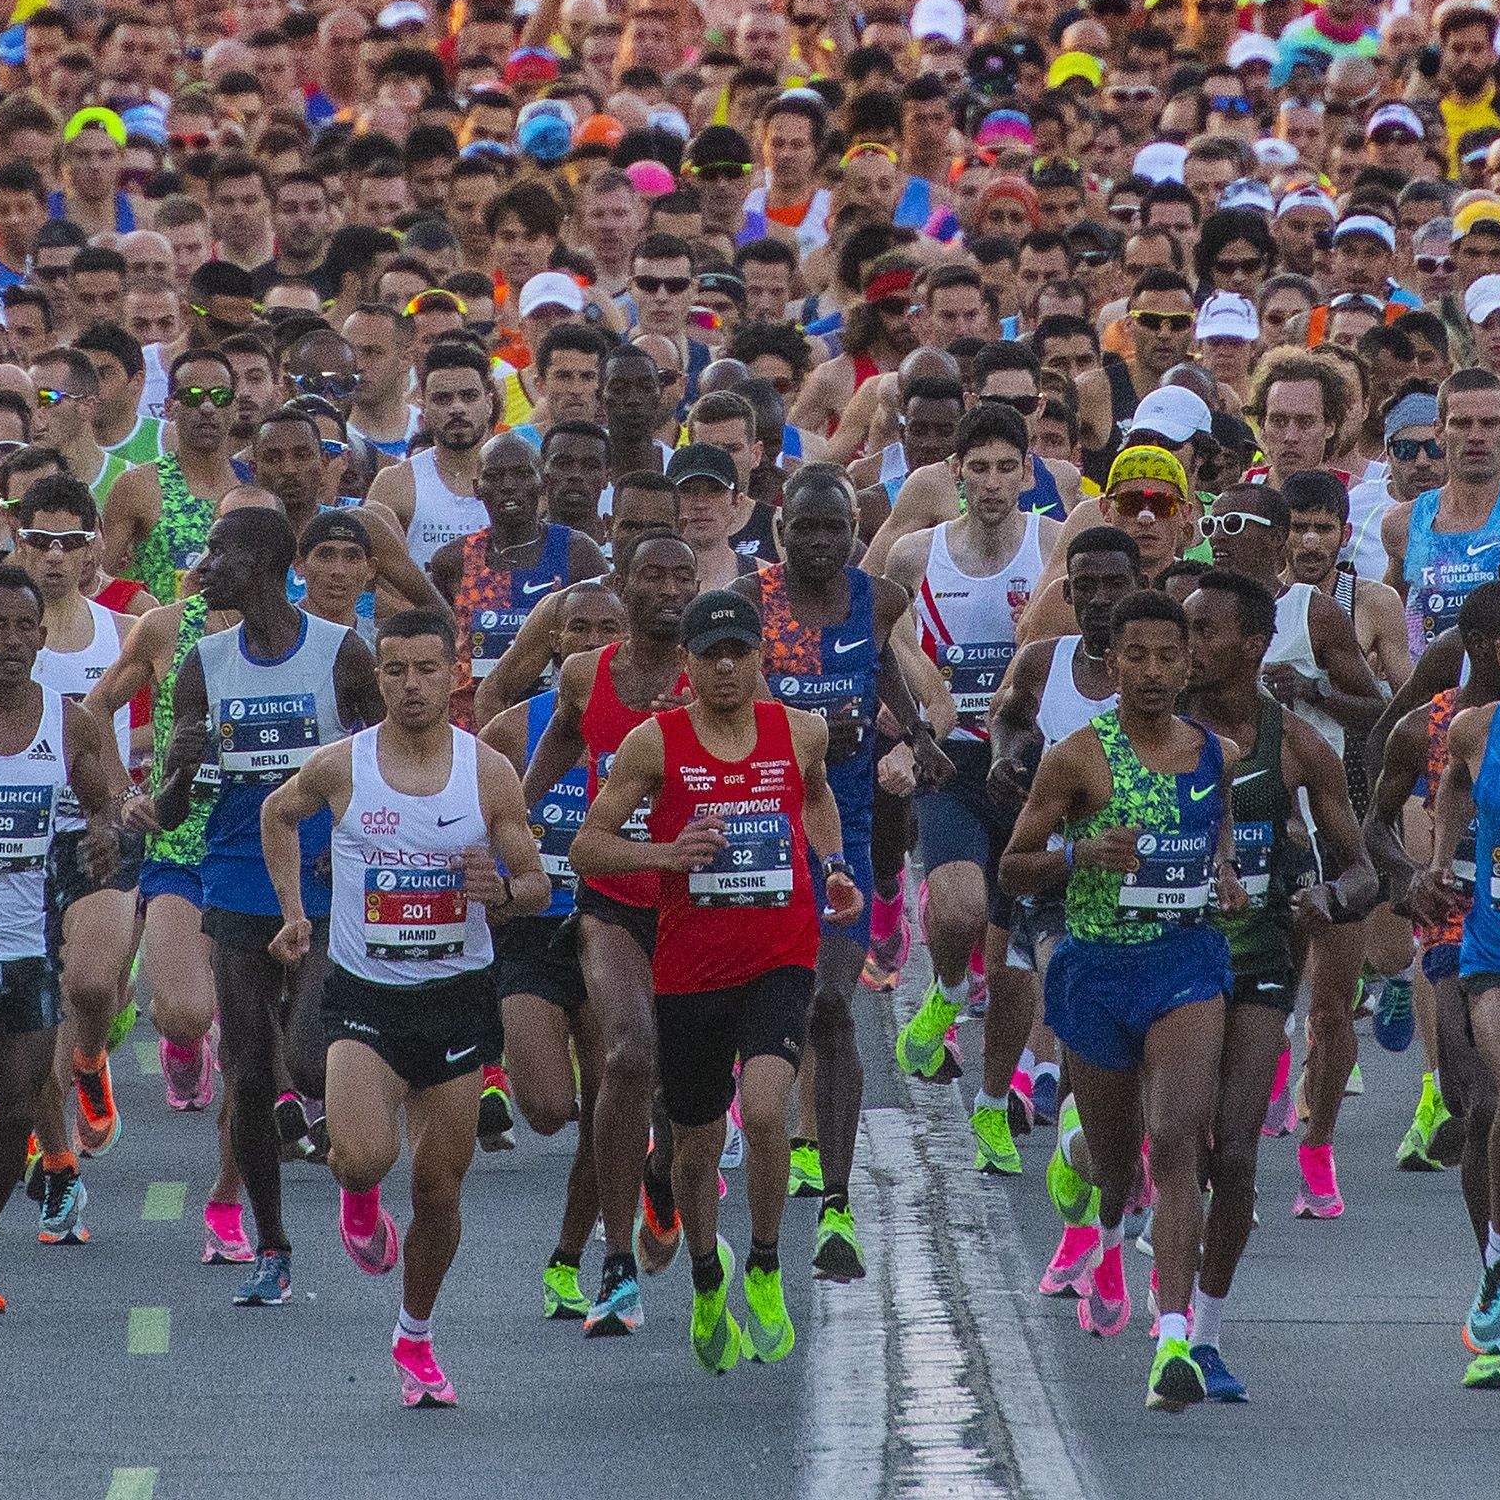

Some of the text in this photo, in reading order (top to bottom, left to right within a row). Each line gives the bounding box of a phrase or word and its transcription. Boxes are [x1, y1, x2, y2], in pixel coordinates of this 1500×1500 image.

[1440, 564, 1470, 575] RAND
[710, 608, 737, 621] GORE
[803, 679, 854, 695] ZURICH
[976, 672, 995, 687] 47
[248, 702, 304, 716] ZURICH
[258, 728, 281, 744] 98
[250, 753, 290, 767] MENJO
[723, 774, 746, 785] GORE
[360, 808, 400, 827] ada
[724, 820, 780, 835] ZURICH
[732, 849, 754, 866] 32
[399, 874, 457, 889] ZURICH
[1164, 866, 1186, 882] 34
[717, 875, 767, 889] YASSINE
[402, 902, 432, 919] 201
[398, 929, 437, 941] HAMID
